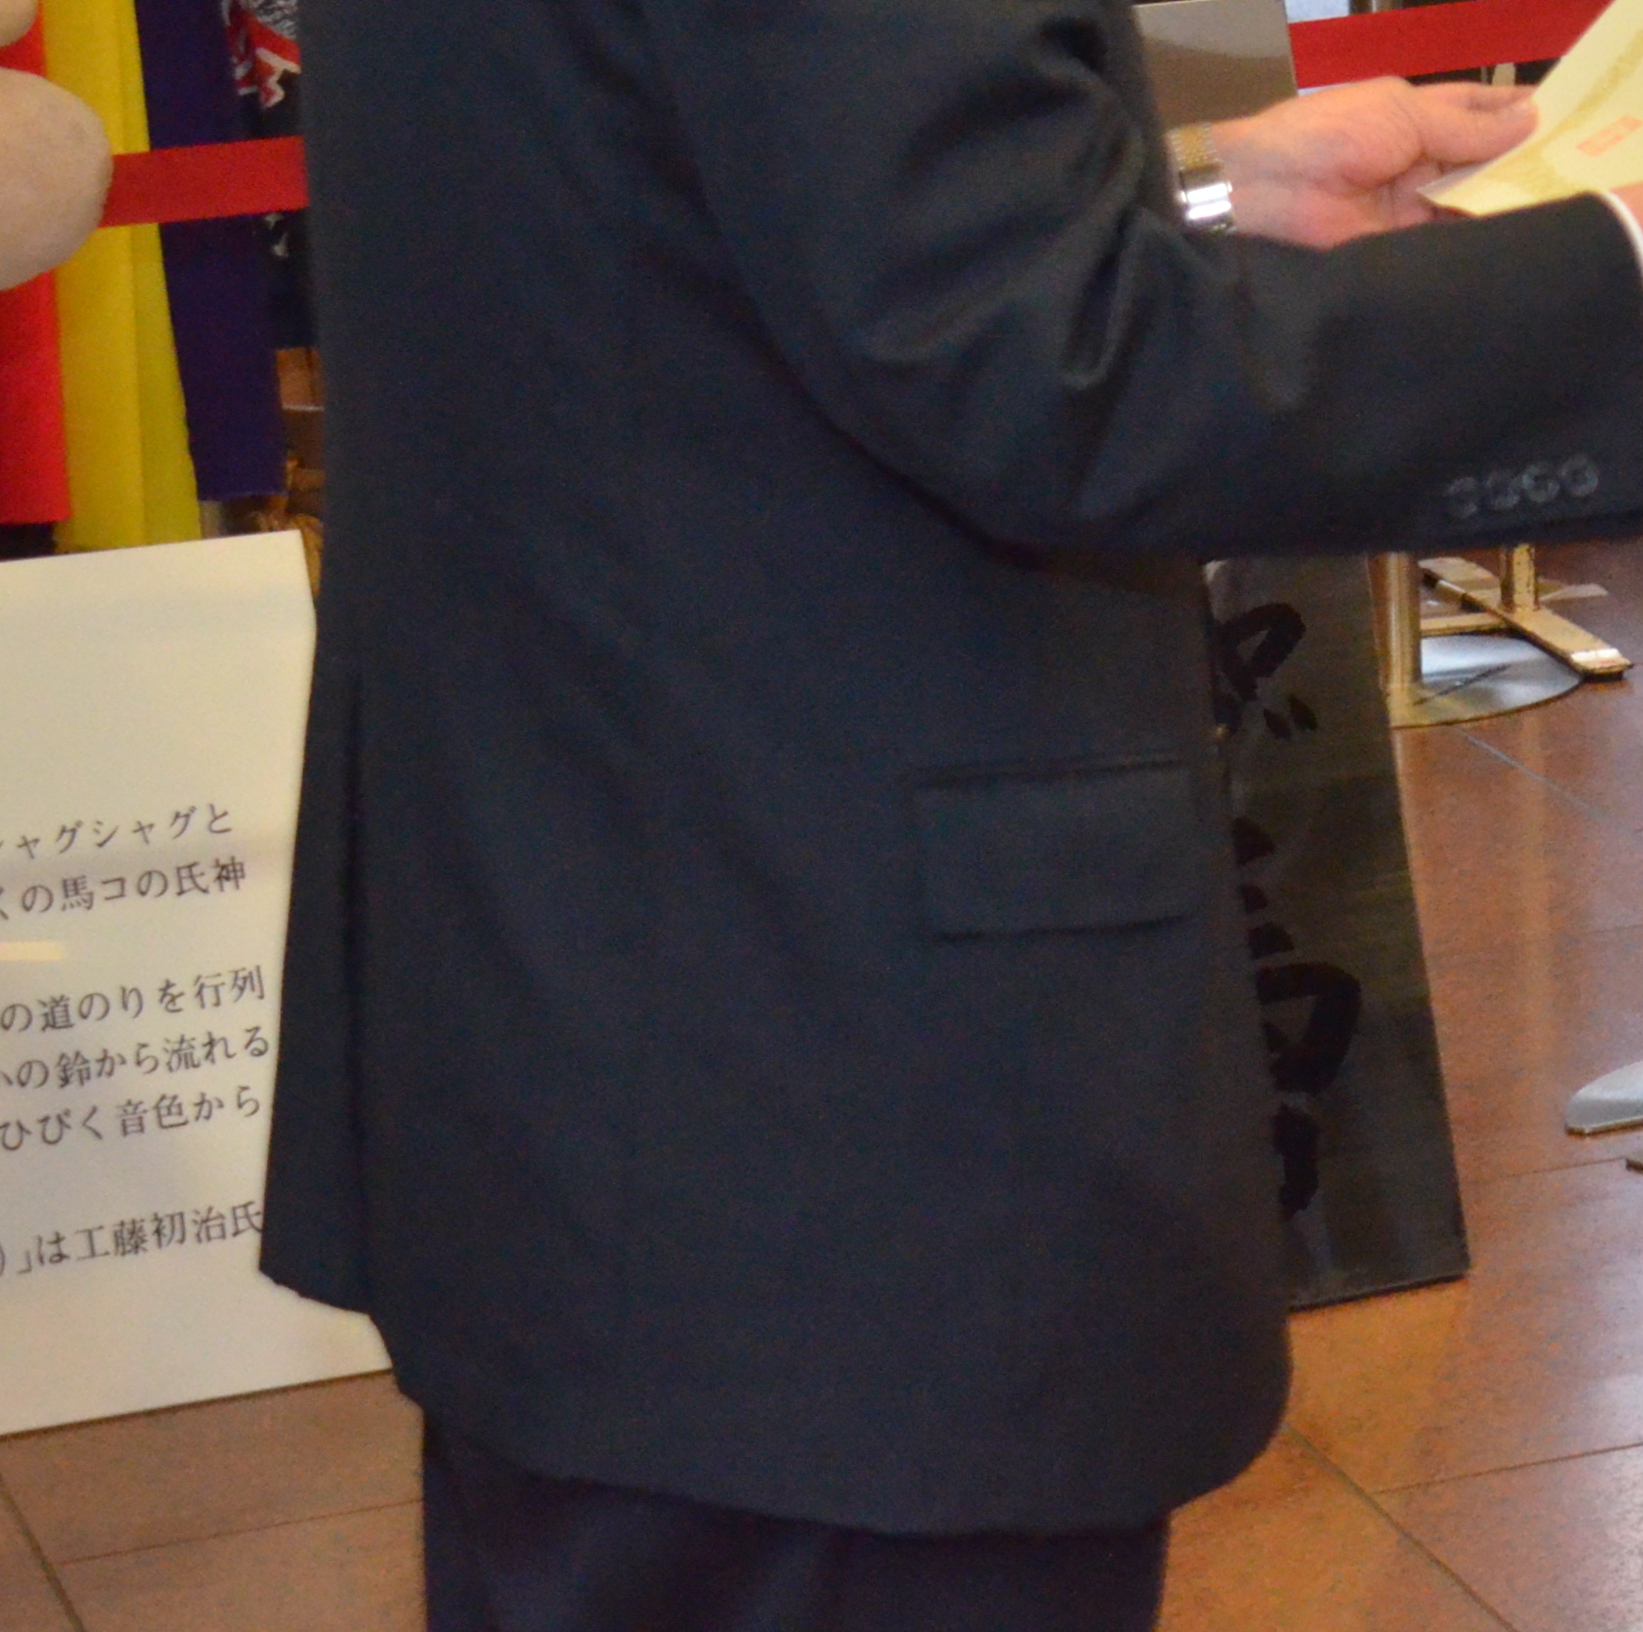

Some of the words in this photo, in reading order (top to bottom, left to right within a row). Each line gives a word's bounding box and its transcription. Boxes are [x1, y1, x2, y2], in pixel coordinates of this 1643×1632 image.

[0, 802, 232, 860] ャグシャグと
[0, 965, 266, 1033] の道のりを行列
[0, 1025, 270, 1089] の鈴から流れる
[0, 1085, 260, 1151] ひびく音色から
